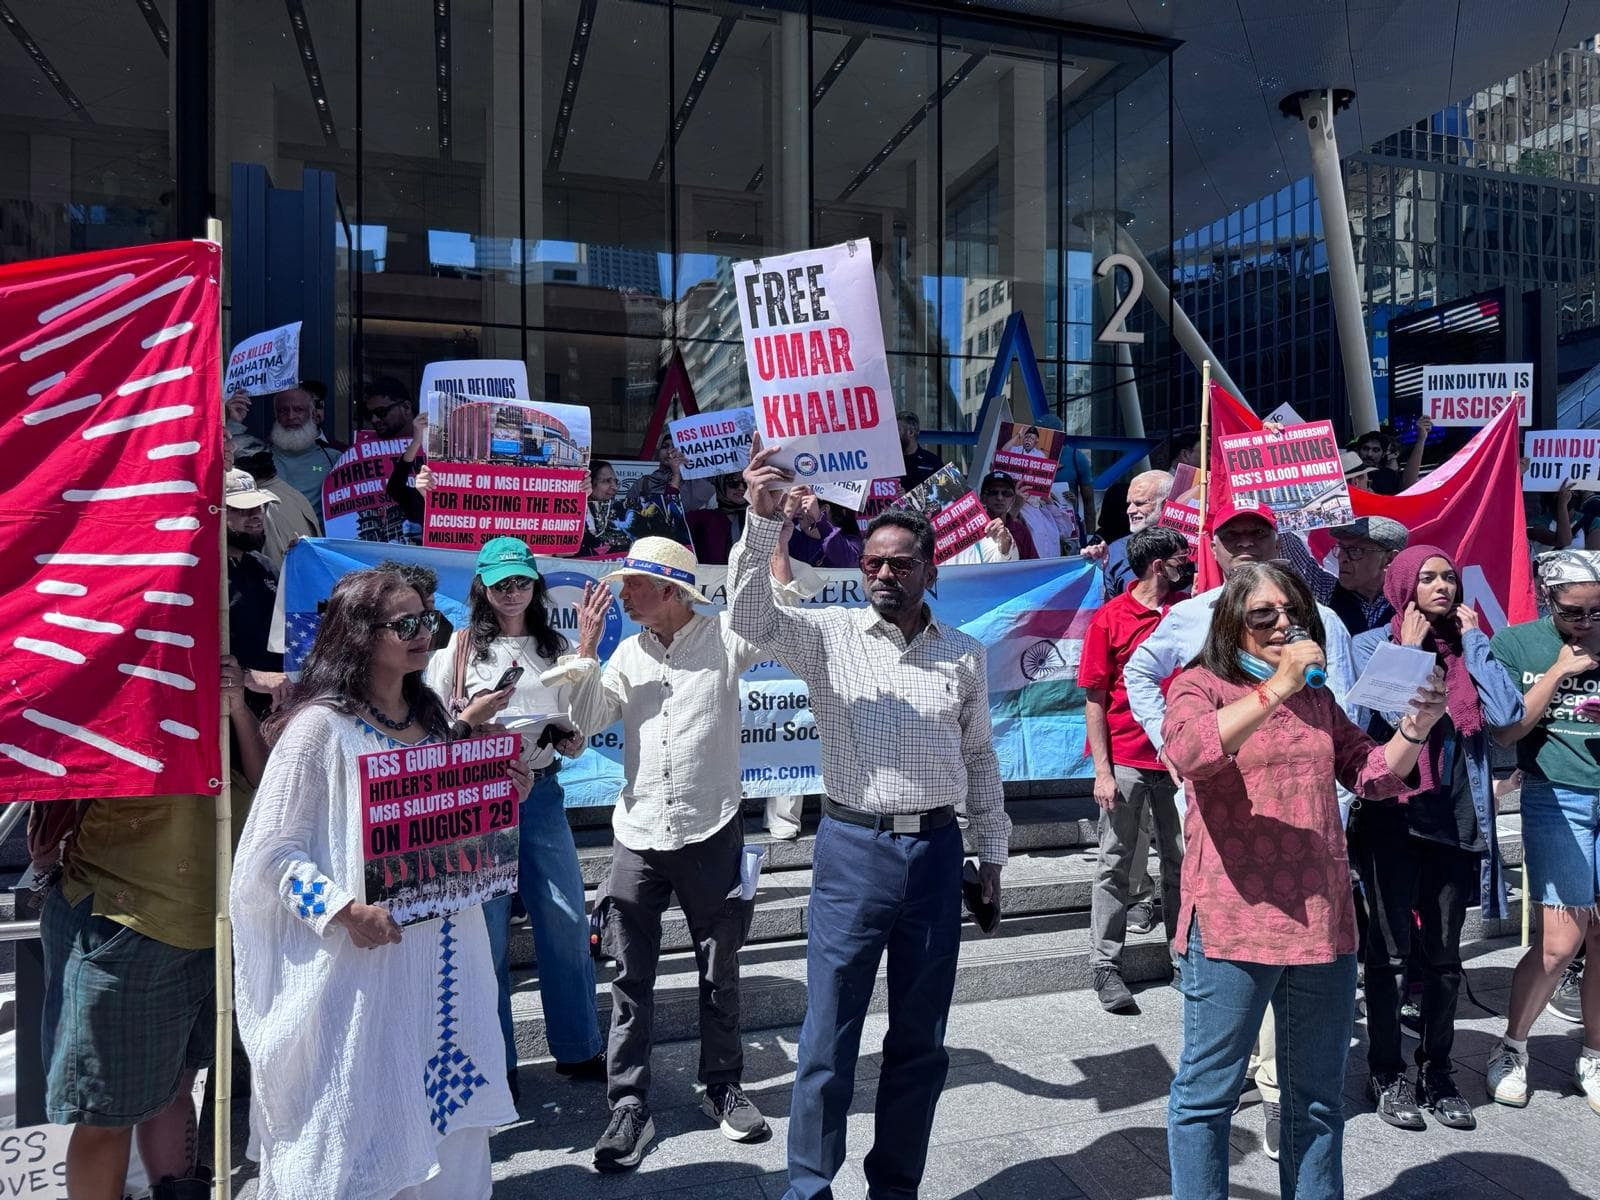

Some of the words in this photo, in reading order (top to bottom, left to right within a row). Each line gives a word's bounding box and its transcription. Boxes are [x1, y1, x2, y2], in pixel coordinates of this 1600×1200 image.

[744, 264, 830, 329] FREE
[1097, 254, 1144, 344] 2
[247, 341, 273, 359] KILLED
[754, 327, 855, 382] UMAR
[229, 354, 284, 380] MAHATMA
[226, 373, 267, 394] GANDHI
[434, 379, 464, 395] INDIA
[467, 378, 516, 399] BELONGS
[1428, 372, 1507, 391] HINDUTVA
[1514, 371, 1530, 389] IS
[762, 386, 880, 439] KHALID
[677, 428, 698, 443] RSS
[700, 421, 736, 438] KILLED
[1223, 438, 1251, 450] SHAME
[1252, 436, 1263, 445] ON
[1285, 425, 1330, 441] LEADERSHIP
[680, 434, 753, 456] MAHATMA
[1226, 447, 1264, 473] FOR
[1267, 437, 1337, 466] TAKING
[684, 450, 739, 470] GANDHI
[819, 450, 868, 473] IAMC
[1529, 462, 1563, 480] OUT
[1571, 463, 1592, 480] OF
[331, 459, 384, 487] THREE
[431, 472, 472, 489] SHAME
[476, 475, 490, 490] ON
[494, 477, 520, 490] MSG
[1231, 471, 1263, 488] RSS'S
[1264, 466, 1299, 483] BLOOD
[1301, 460, 1339, 478] MONEY
[328, 487, 350, 504] NEW
[354, 479, 383, 496] YORK
[873, 481, 896, 497] RSS
[329, 494, 375, 516] MADISON
[431, 492, 458, 509] FOR
[463, 494, 522, 513] HOSTING
[526, 497, 549, 513] THE
[553, 498, 582, 516] RSS,
[430, 515, 476, 529] ACCUSED
[479, 517, 491, 529] OF
[494, 517, 539, 531] VIOLENCE
[541, 519, 581, 532] AGAINST
[1164, 507, 1185, 520] MSG
[1185, 512, 1200, 526] HOS
[429, 532, 477, 546] MUSLIMS,
[529, 534, 579, 546] CHRISTIANS
[936, 532, 958, 551] CHIEF
[741, 722, 776, 744] and
[783, 721, 820, 742] Soc
[367, 754, 401, 779] RSS
[405, 745, 447, 773] GURU
[451, 736, 514, 765] PRAISED
[369, 774, 433, 802] HITLER'S
[369, 803, 400, 824] MSG
[404, 792, 455, 817] SALUTES
[457, 787, 480, 807] RSS
[482, 781, 513, 800] CHIEF
[371, 824, 401, 855] ON
[408, 806, 483, 848] AUGUST
[488, 800, 514, 829] 29
[0, 1131, 47, 1164] SS
